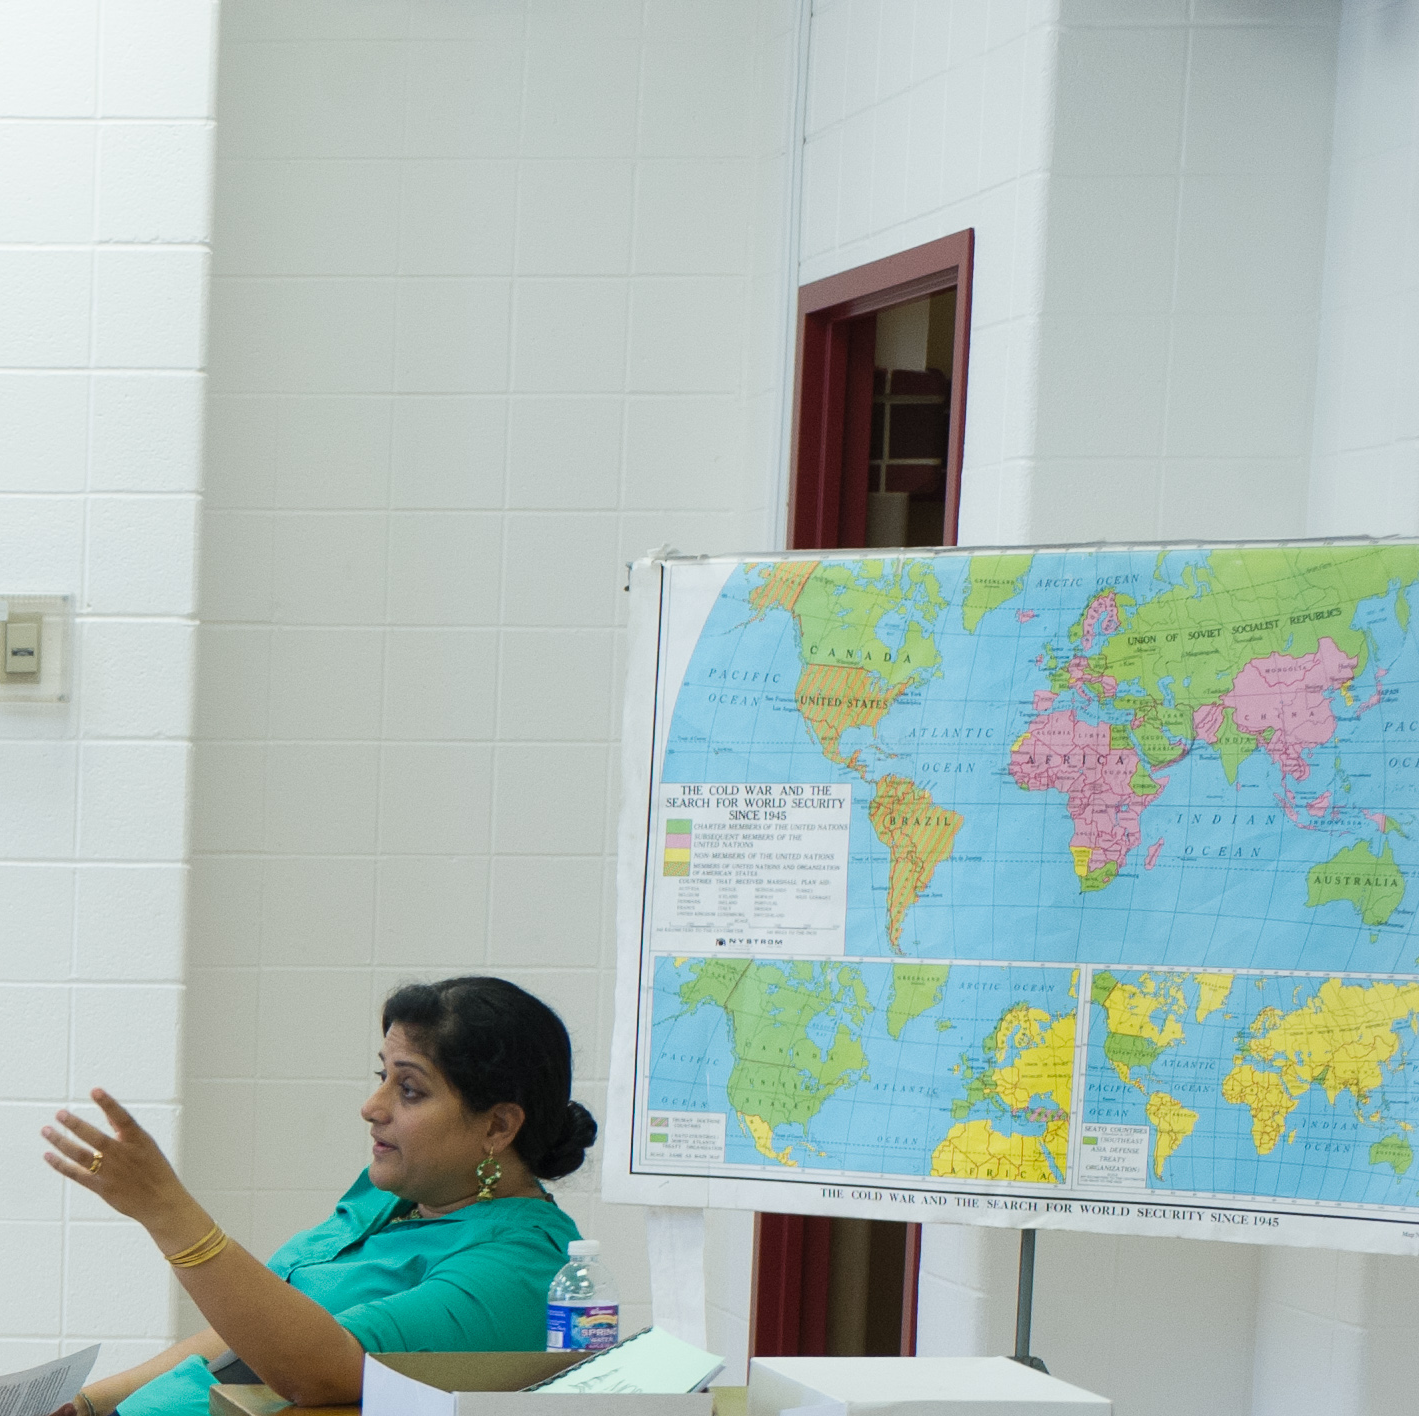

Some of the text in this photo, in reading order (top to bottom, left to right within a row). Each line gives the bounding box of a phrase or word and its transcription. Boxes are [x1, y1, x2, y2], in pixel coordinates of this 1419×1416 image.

[1035, 573, 1140, 589] ARCTIC OCEAN
[1127, 634, 1157, 646] UNION
[1165, 633, 1179, 643] OF
[1187, 628, 1222, 641] SOVIET
[1231, 619, 1280, 635] SOCIALIST
[1289, 607, 1342, 626] REPUBLICS
[810, 645, 911, 664] CANADA
[708, 668, 782, 684] PACIFIC
[708, 693, 759, 707] OCEAN
[800, 695, 841, 708] UNITED
[847, 697, 888, 709] STATES
[1244, 711, 1315, 722] CHINA
[908, 727, 994, 738] ATLANTIC
[1027, 754, 1125, 766] AFRICA
[921, 762, 976, 773] OCEAN
[680, 785, 832, 796] THE COLD WAR AND THE
[665, 798, 845, 809] SEARCH FOR WORLD SECURITY
[728, 810, 787, 821] SINCE 1945
[1176, 813, 1276, 825] INDIAN
[693, 823, 726, 831] CHARTER
[890, 816, 951, 827] BRAZIL
[693, 841, 720, 849] UNITED
[803, 853, 835, 861] NATIONS
[1184, 845, 1262, 858] OCEAN
[1313, 875, 1399, 888] AUSTRALIA
[729, 938, 783, 946] NYSTROM
[959, 982, 1056, 993] ARCTIC OCEAN
[661, 1052, 720, 1066] PACIFIC
[1162, 1059, 1215, 1070] ATLANTIC
[873, 1083, 938, 1096] ATLANTIC
[1088, 1083, 1134, 1094] PACIFIC
[1174, 1084, 1210, 1093] OCEAN
[661, 1096, 709, 1109] OCEAN
[1089, 1108, 1129, 1118] OCEAN
[1302, 1117, 1359, 1130] INDIAN
[1109, 1126, 1148, 1134] COUNTRIES
[876, 1136, 918, 1145] OCEAN
[1109, 1147, 1140, 1155] DEFENSE
[1305, 1143, 1350, 1153] OCEAN
[951, 1167, 1048, 1180] AFRICA
[820, 1187, 1280, 1227] THE COLD WAR AND THE SEARCH FOR WORLD SECURITY SINCE 1945
